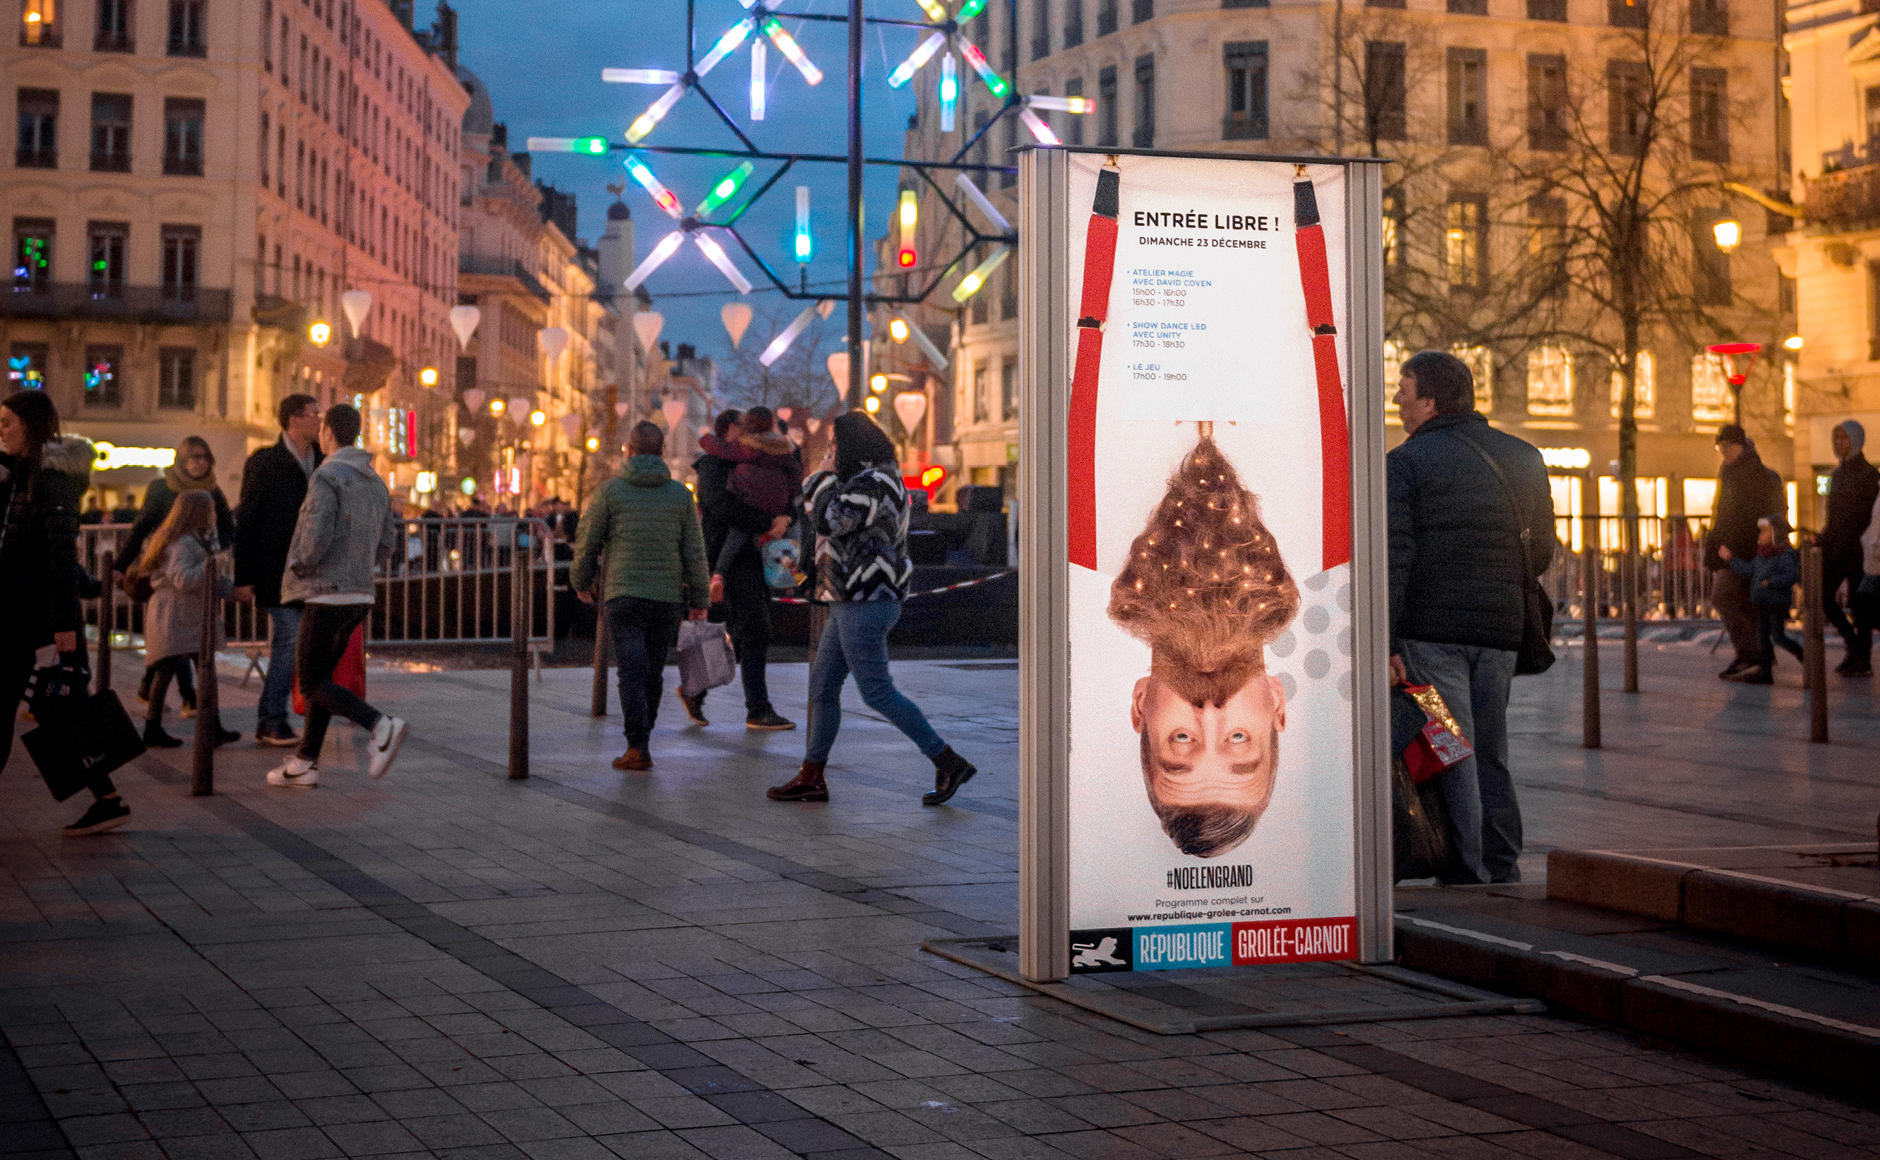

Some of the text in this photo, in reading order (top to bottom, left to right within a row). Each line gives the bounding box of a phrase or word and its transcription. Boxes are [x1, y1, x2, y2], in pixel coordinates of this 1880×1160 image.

[1134, 209, 1279, 232] ENTRÉE LIBRE !
[1139, 236, 1267, 249] DIMANCHE 23 DÉCEMBRE
[1132, 269, 1166, 277] ATELIER
[1132, 278, 1154, 286] AVEC
[1132, 288, 1156, 296] 15h00
[1163, 289, 1187, 297] 16h00
[1132, 298, 1155, 306] 16h30
[1163, 299, 1185, 307] 17h30
[1160, 322, 1189, 330] DANCE
[1190, 323, 1207, 331] LED
[1132, 340, 1155, 348] 17h30
[1162, 340, 1185, 348] 18h30
[1132, 363, 1161, 371] LE JEU
[1132, 372, 1156, 380] 17h00
[1163, 373, 1187, 381] 19h00
[1166, 864, 1253, 890] #NOELENGRAND
[1155, 895, 1265, 909] Programme complet sur
[1127, 906, 1292, 922] www.republique-grolee-carnot.com
[1140, 930, 1224, 964] RÉPUBLIQUE
